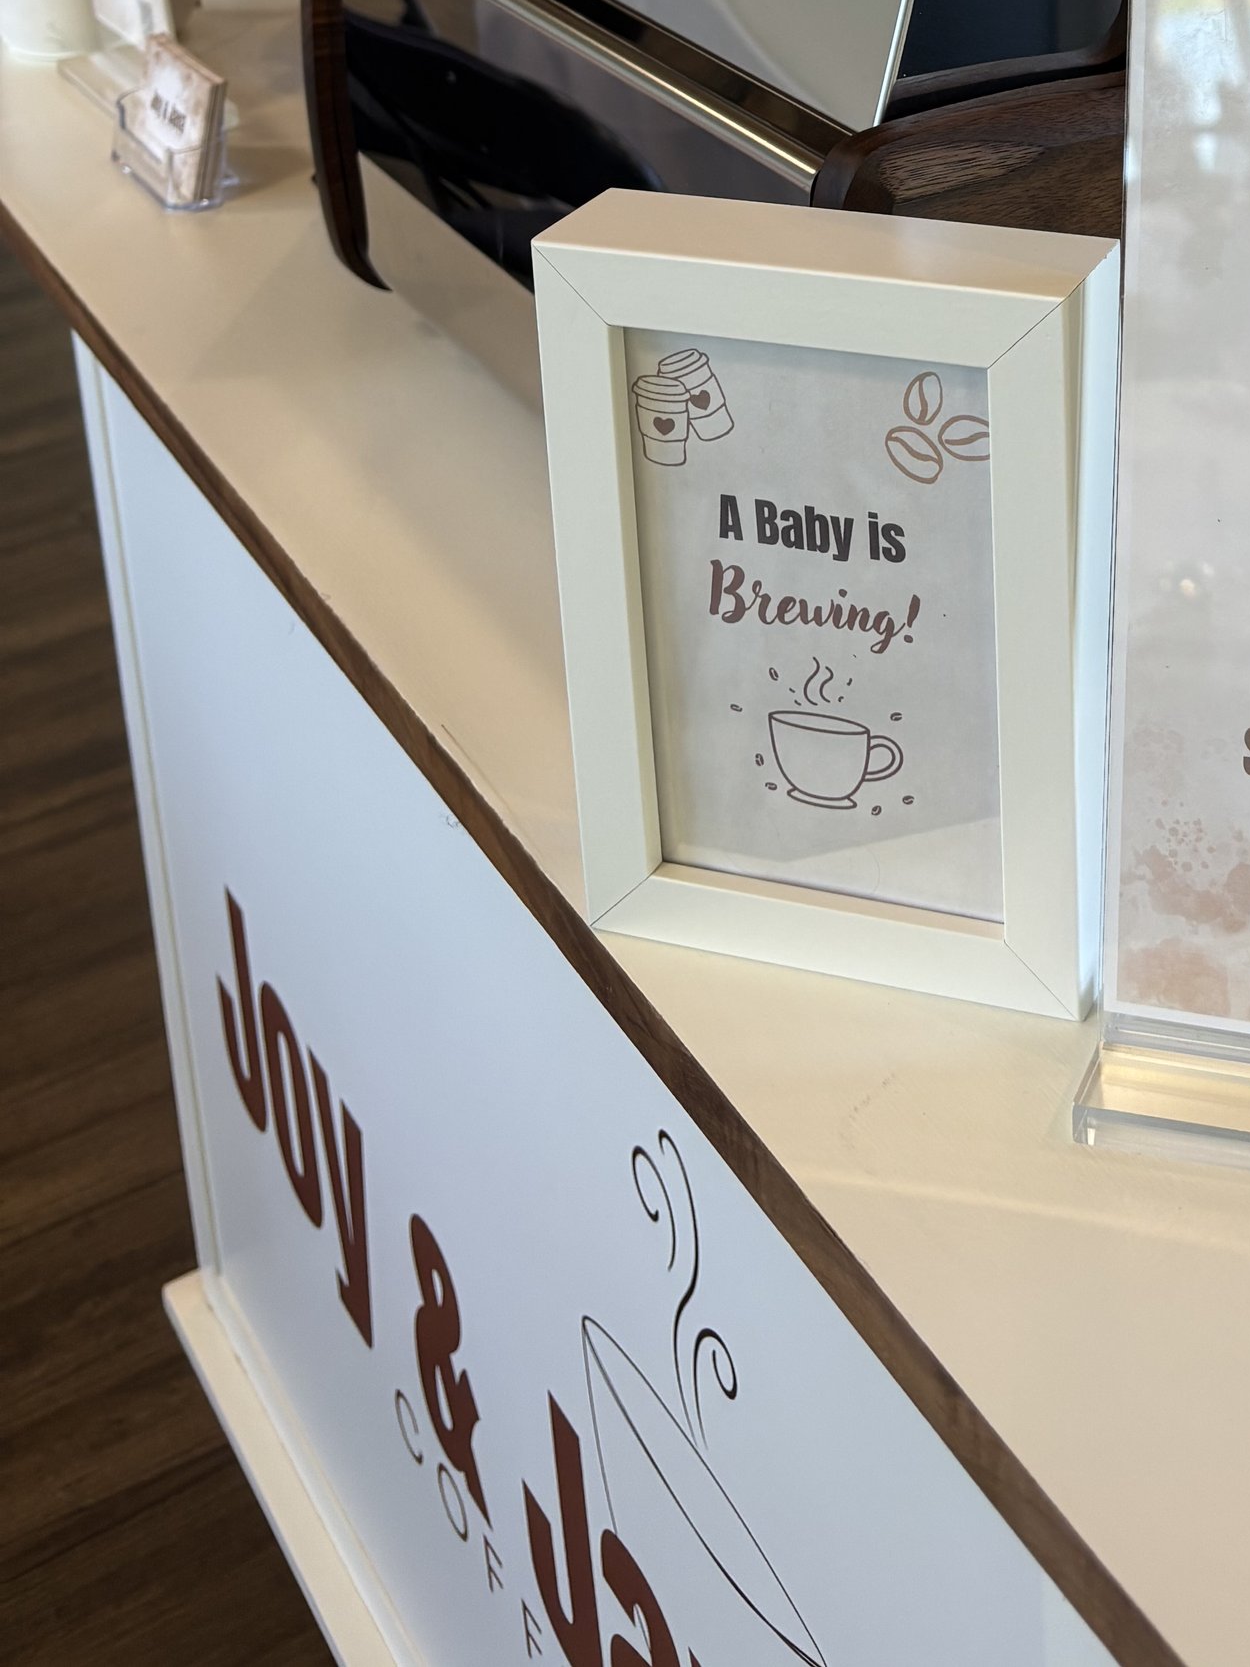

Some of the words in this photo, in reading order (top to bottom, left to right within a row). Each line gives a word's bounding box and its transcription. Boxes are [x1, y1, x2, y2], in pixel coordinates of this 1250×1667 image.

[719, 493, 744, 542] A
[754, 498, 855, 563] Baby
[868, 511, 907, 564] is
[708, 559, 922, 655] Brewing!
[409, 1213, 494, 1532] &
